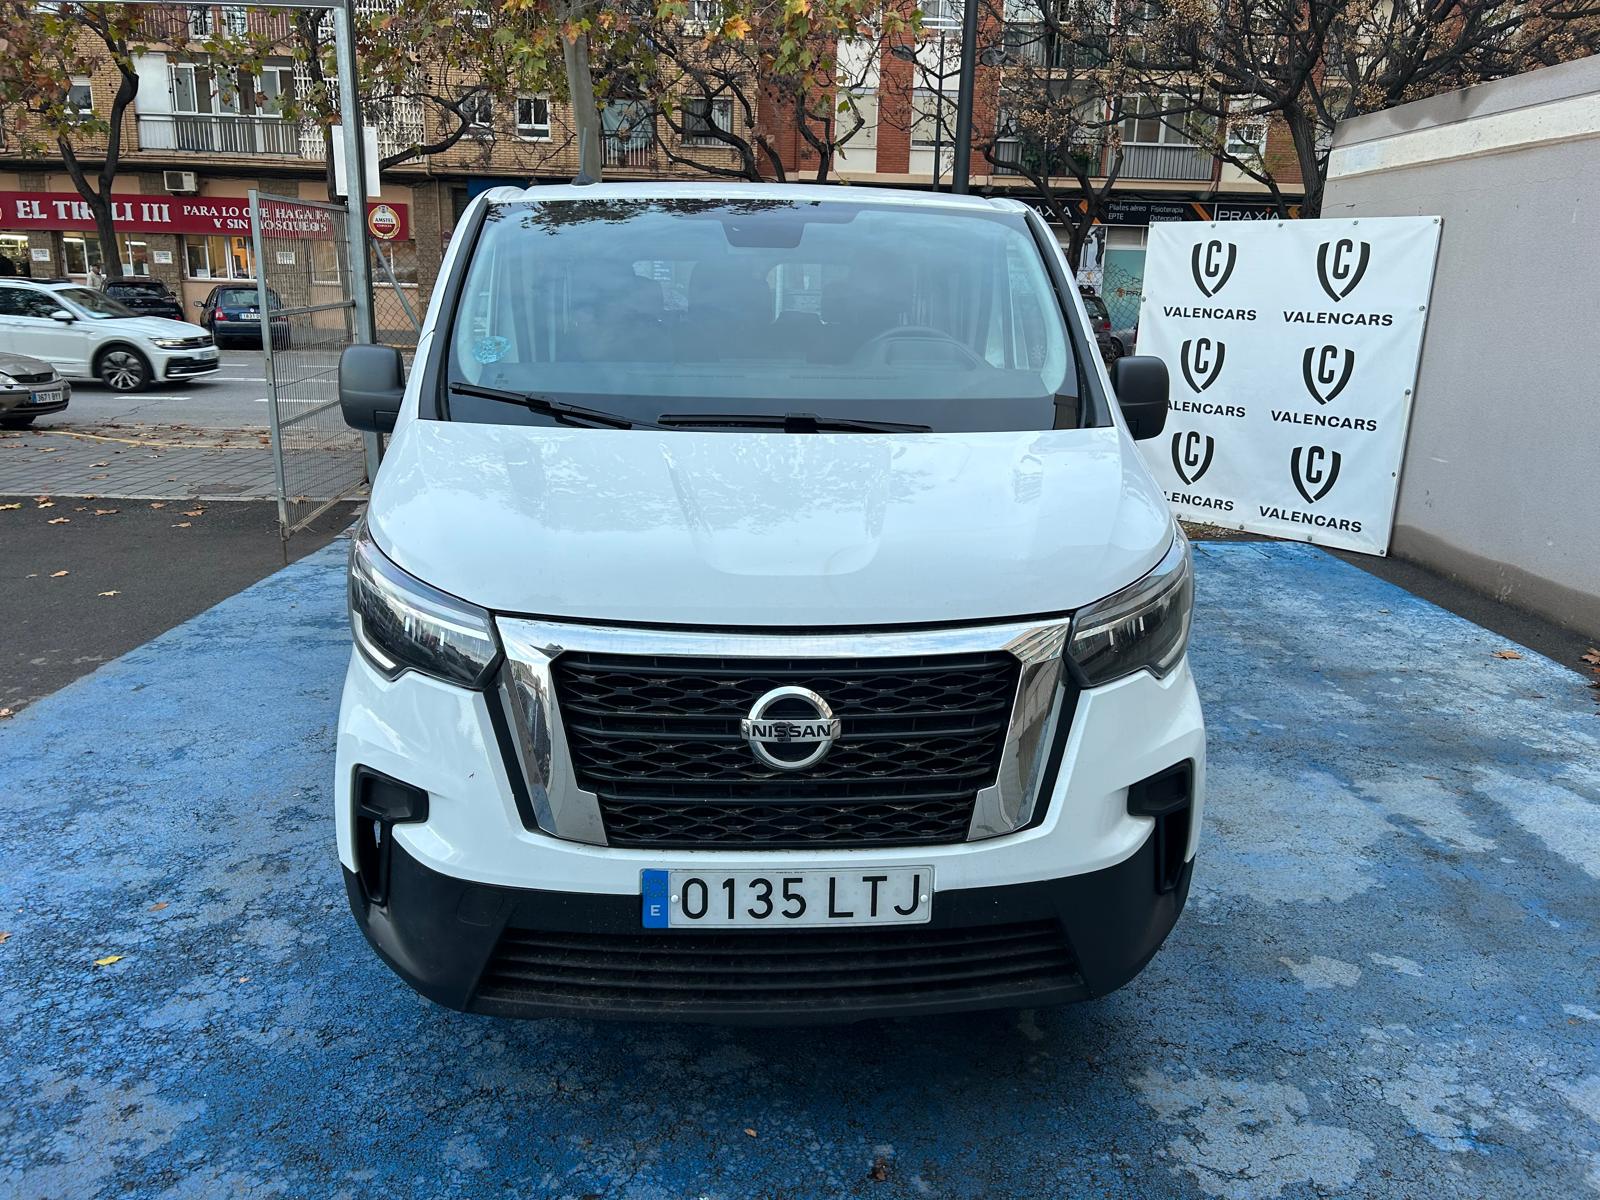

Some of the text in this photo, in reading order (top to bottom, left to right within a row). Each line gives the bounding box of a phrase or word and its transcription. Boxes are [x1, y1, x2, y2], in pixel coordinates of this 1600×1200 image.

[16, 200, 171, 222] EL TIRLI III
[183, 205, 219, 216] PARA
[222, 207, 240, 217] LO
[227, 219, 249, 229] SIN
[1163, 306, 1257, 321] VALENCARS
[1283, 311, 1394, 327] VALENCARS
[1167, 400, 1246, 418] ALENCARS
[1271, 410, 1378, 431] VALENCARS
[1164, 491, 1235, 511] LENCARS
[1259, 505, 1363, 533] VALENCARS
[751, 723, 832, 739] NISSAN
[681, 874, 920, 920] 0135 LTJ
[650, 904, 661, 916] E
